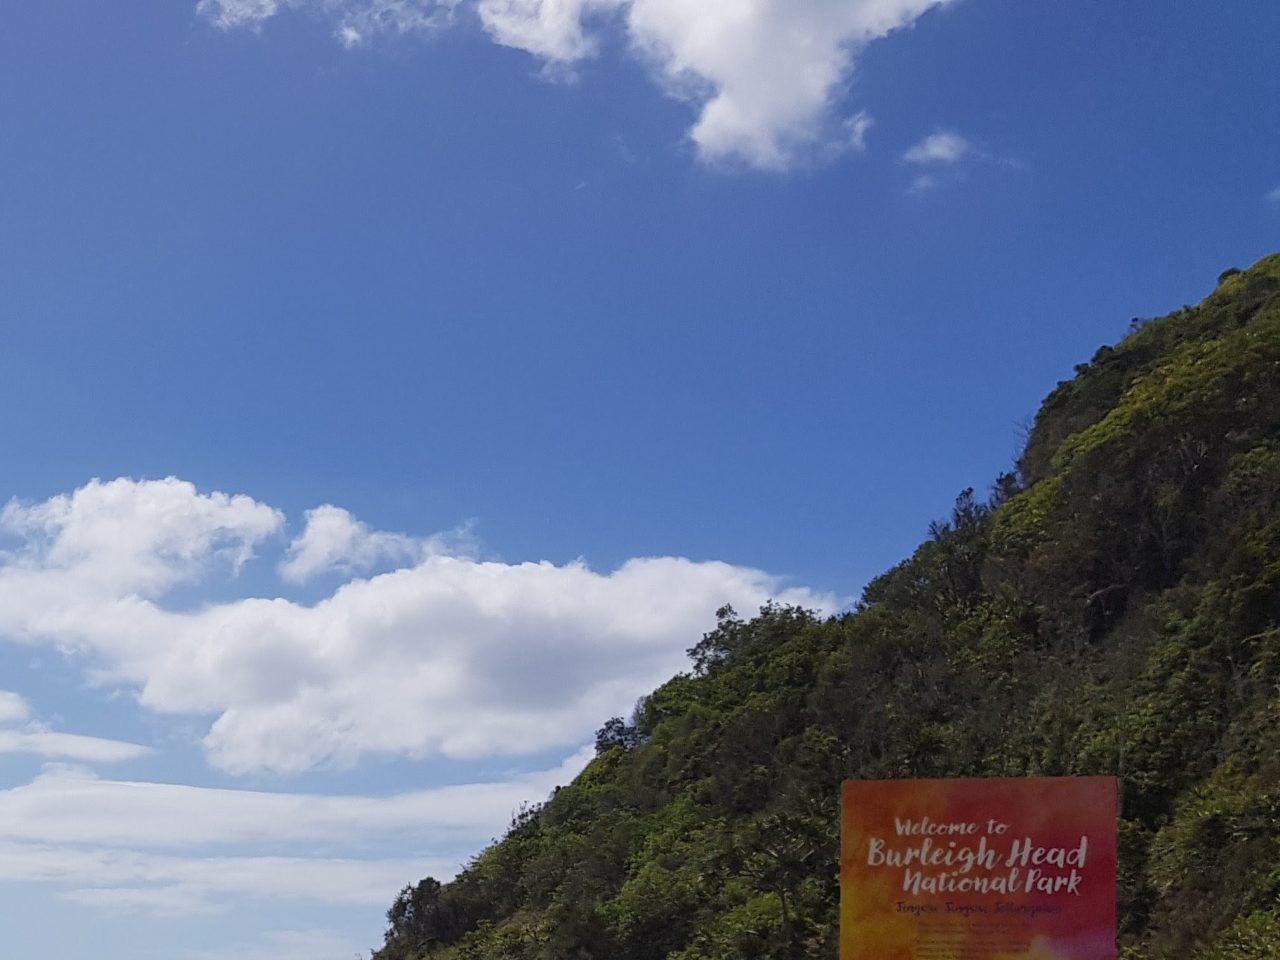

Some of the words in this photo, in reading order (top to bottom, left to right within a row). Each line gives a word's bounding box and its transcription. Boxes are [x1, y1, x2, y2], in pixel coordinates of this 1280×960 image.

[894, 816, 979, 836] Welcome
[987, 818, 1010, 835] to
[867, 836, 1002, 874] Burleigh
[1005, 836, 1088, 868] Head
[902, 867, 1022, 895] National
[1025, 868, 1082, 897] Park
